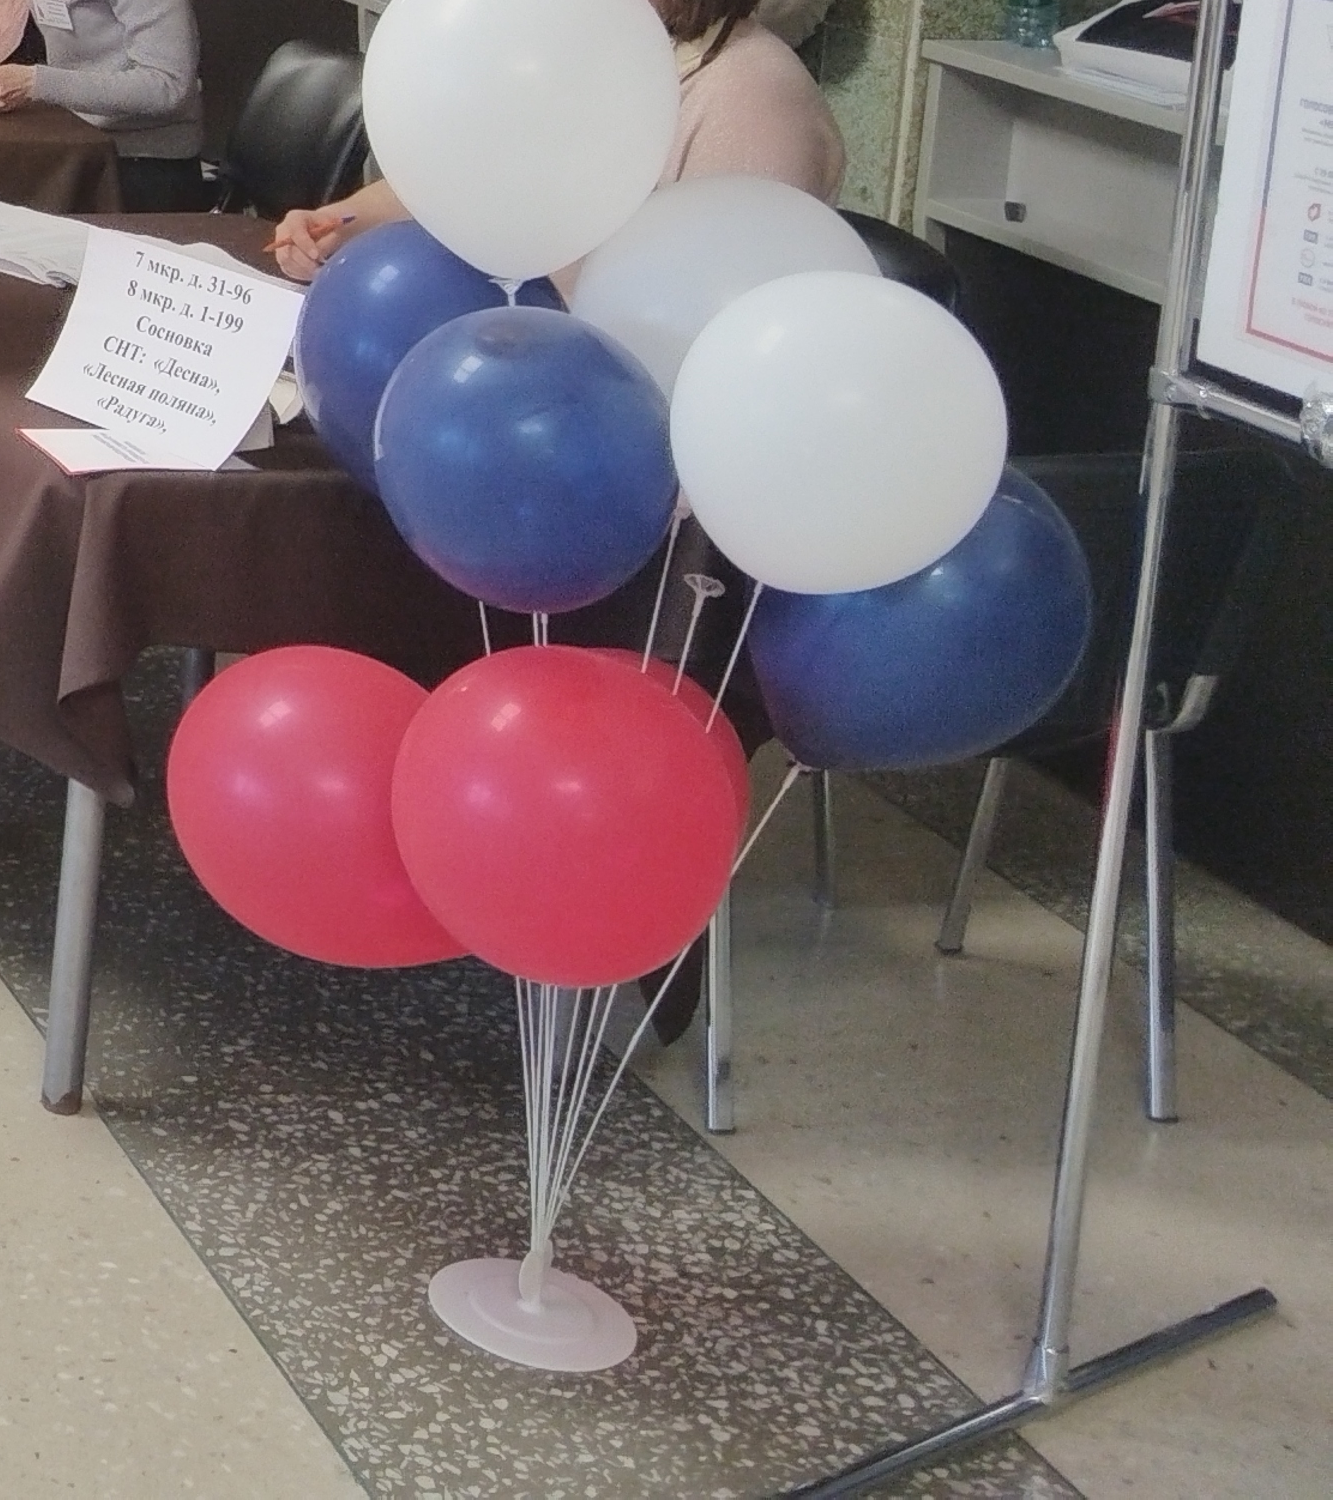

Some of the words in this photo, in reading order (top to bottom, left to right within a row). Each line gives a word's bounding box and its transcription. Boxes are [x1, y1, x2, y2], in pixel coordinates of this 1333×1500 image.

[136, 251, 145, 268] 7
[147, 260, 184, 283] мкр.
[188, 274, 203, 290] д.
[207, 276, 254, 305] 31-96
[127, 280, 138, 297] 8
[140, 289, 176, 313] мкр.
[180, 303, 194, 319] д.
[200, 306, 244, 334] 1-199
[136, 315, 213, 358] Сосновка
[103, 335, 147, 364] СНТ:
[153, 357, 221, 396] «Десна»,
[83, 362, 147, 396] «Лесная
[147, 388, 217, 426] поляна»,
[97, 395, 168, 434] «Радуга»,
